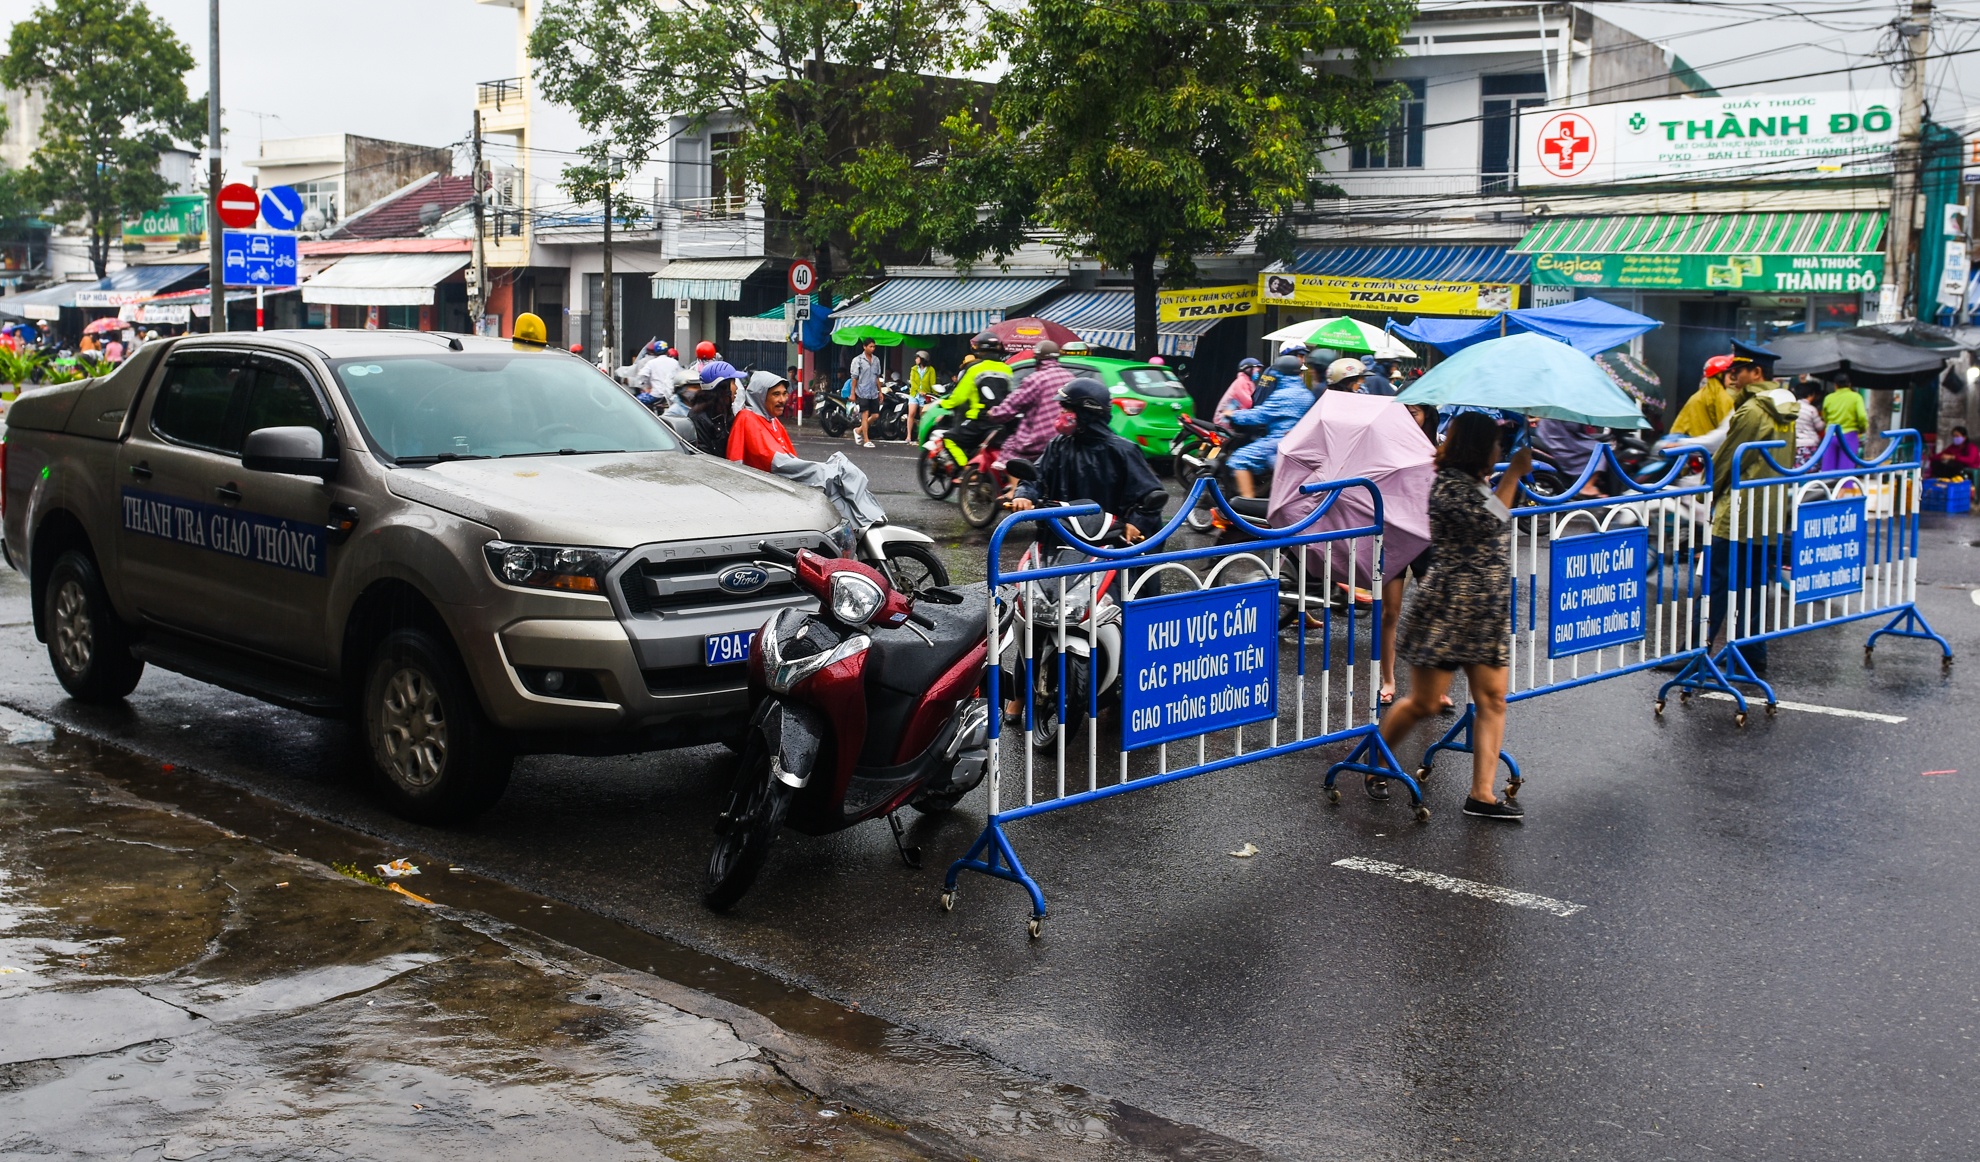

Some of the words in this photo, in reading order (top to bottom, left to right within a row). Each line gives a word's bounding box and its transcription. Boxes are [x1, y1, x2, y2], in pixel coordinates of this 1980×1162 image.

[1658, 112, 1809, 141] THÀNH
[1828, 104, 1893, 134] ĐÔ
[796, 269, 808, 285] 40
[1792, 255, 1819, 269] NHÀ
[1820, 255, 1862, 269] THUỐC
[1327, 277, 1348, 288] TÓC
[1351, 280, 1360, 288] &
[1774, 269, 1843, 290] THÀNH
[1846, 269, 1877, 291] ĐÔ
[1178, 301, 1252, 318] TRANG
[1349, 291, 1420, 304] TRANG
[123, 495, 173, 538] THANH
[174, 507, 206, 546] TRA
[210, 514, 250, 557] GIAO
[253, 521, 317, 572] THÔNG
[1804, 519, 1821, 539] KHU
[1822, 514, 1838, 539] VỰC
[1840, 507, 1857, 534] CẤM
[1566, 554, 1587, 579] KHU
[1590, 549, 1610, 579] VỰC
[1612, 540, 1634, 572] CẤM
[1799, 545, 1814, 566] CÁC
[1815, 543, 1842, 563] PHƯƠNG
[1843, 539, 1859, 560] TIỆN
[733, 571, 760, 586] Ford
[1560, 587, 1578, 611] CÁC
[1581, 583, 1616, 607] PHƯƠNG
[1618, 577, 1638, 603] TIỆN
[1147, 619, 1181, 652] KHU
[1186, 610, 1218, 648] VỰC
[1223, 598, 1257, 638] CẤM
[1555, 623, 1574, 643] GIAO
[1576, 615, 1601, 639] THÔNG
[1603, 609, 1628, 634] ĐƯỜNG
[1631, 605, 1640, 631] BỘ
[1139, 661, 1167, 692] CÁC
[1173, 653, 1229, 685] PHƯƠNG
[1233, 643, 1264, 674] TIỆN
[1132, 705, 1161, 733] GIAO
[1165, 694, 1206, 725] THÔNG
[1210, 683, 1250, 716] ĐƯỜNG
[1254, 677, 1270, 708] BỘ
